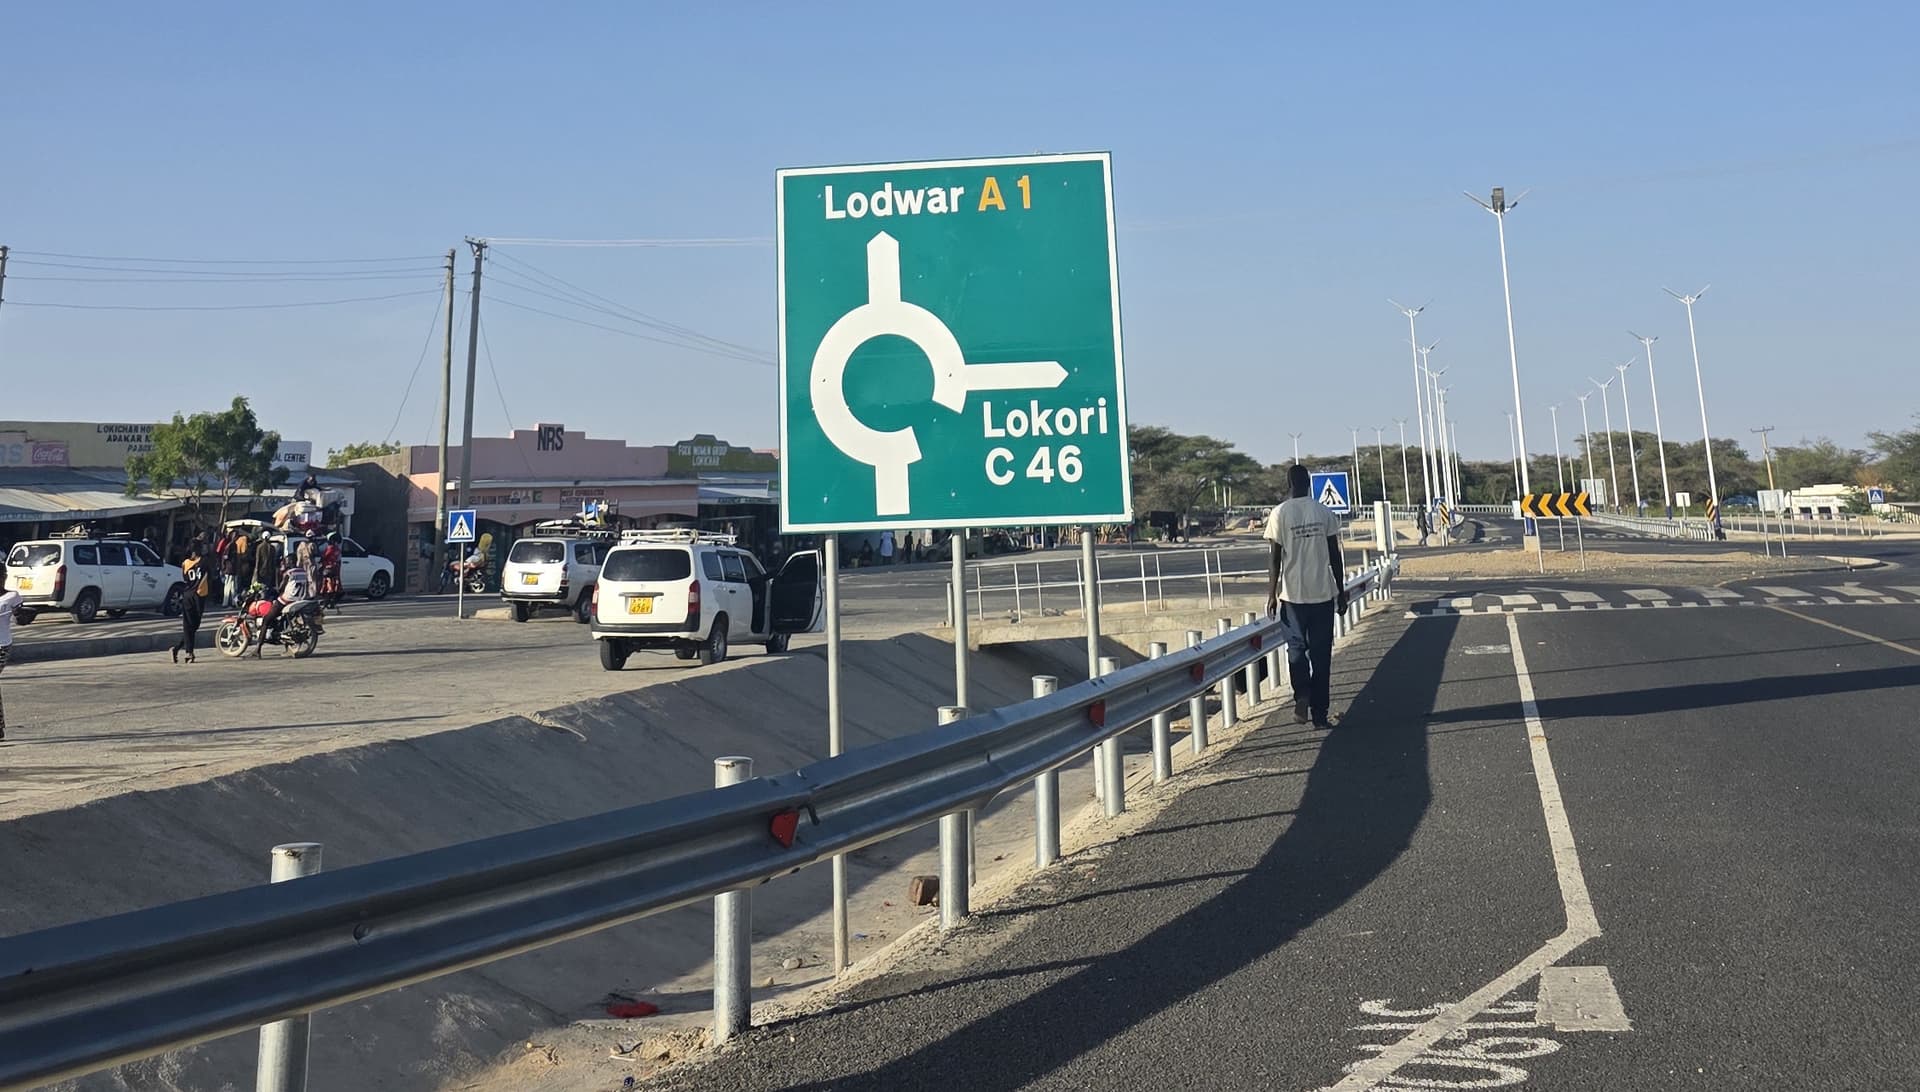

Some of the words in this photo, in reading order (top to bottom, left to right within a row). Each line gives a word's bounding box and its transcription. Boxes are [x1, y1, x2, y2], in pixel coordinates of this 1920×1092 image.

[825, 182, 965, 219] Lodwar
[978, 177, 1006, 211] A
[1017, 175, 1031, 209] 1
[983, 397, 1108, 437] Lokori
[537, 426, 564, 451] NRS
[985, 448, 1015, 485] C
[1026, 445, 1083, 483] 46
[188, 567, 201, 581] 04
